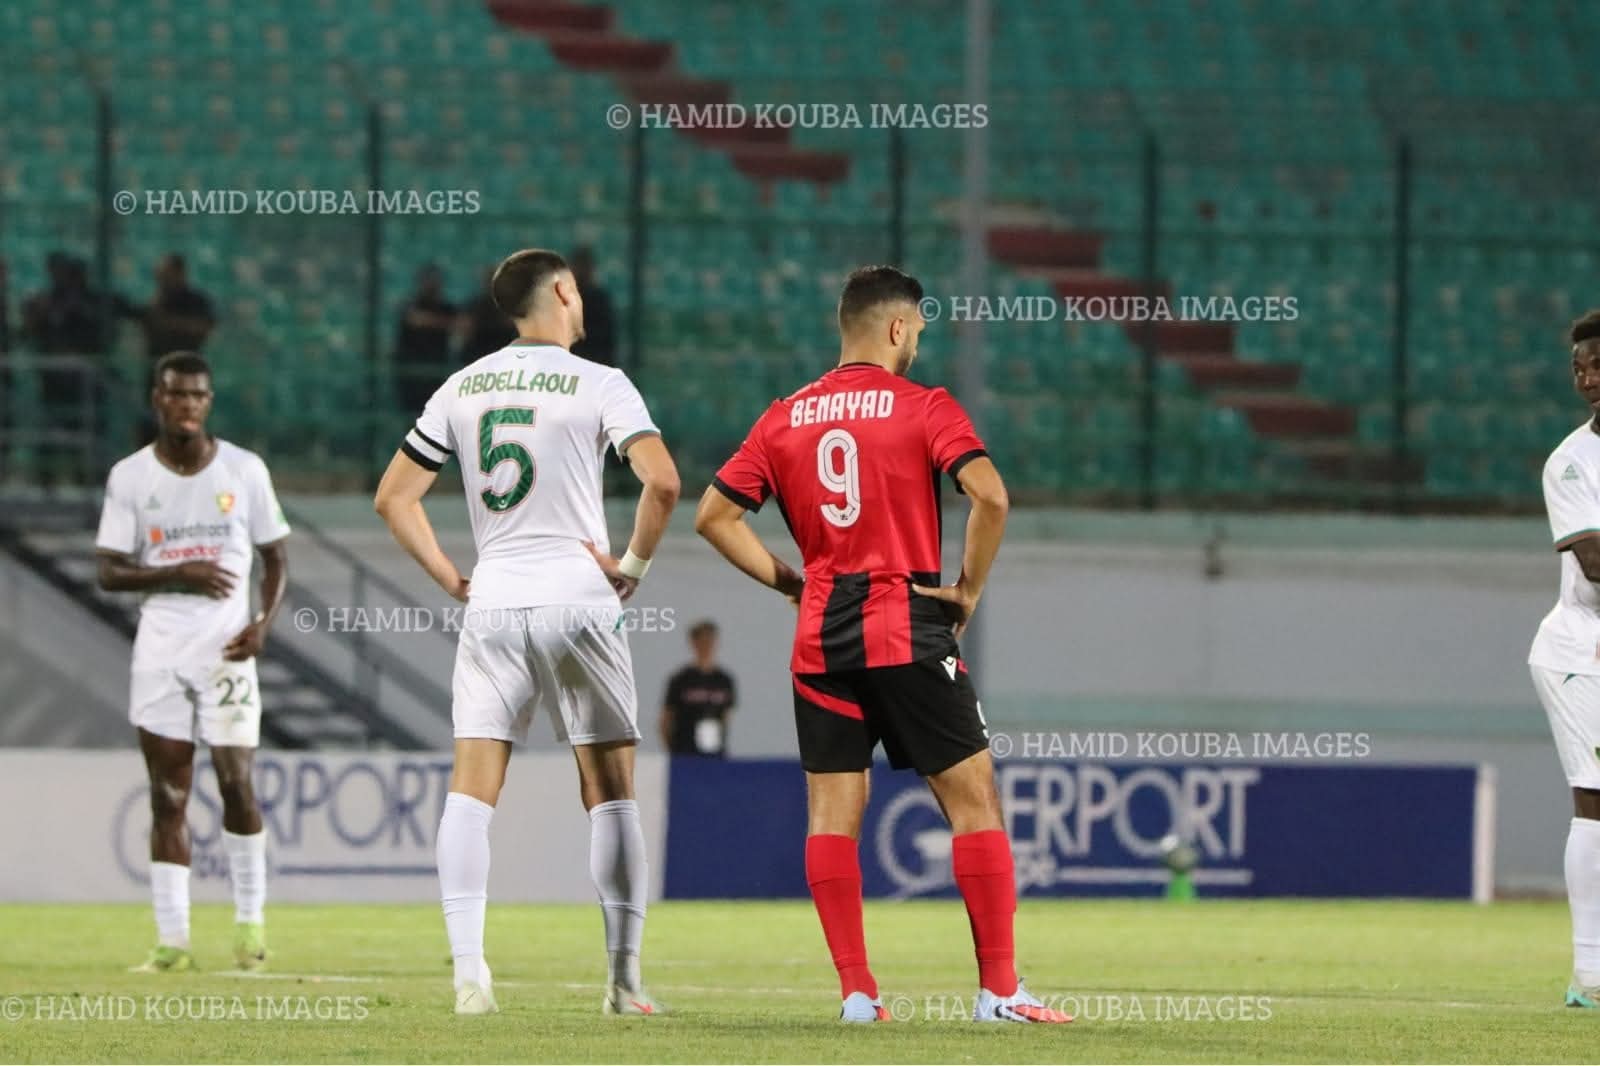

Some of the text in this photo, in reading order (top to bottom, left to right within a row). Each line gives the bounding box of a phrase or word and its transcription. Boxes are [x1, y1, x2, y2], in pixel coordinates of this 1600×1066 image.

[458, 369, 580, 398] ABDELLAOUI
[790, 390, 895, 428] BENAYAD
[478, 404, 538, 515] 5
[817, 428, 861, 528] 9
[215, 676, 253, 707] 22
[191, 760, 456, 847] SRPORT
[1001, 765, 1261, 857] ERPORT
